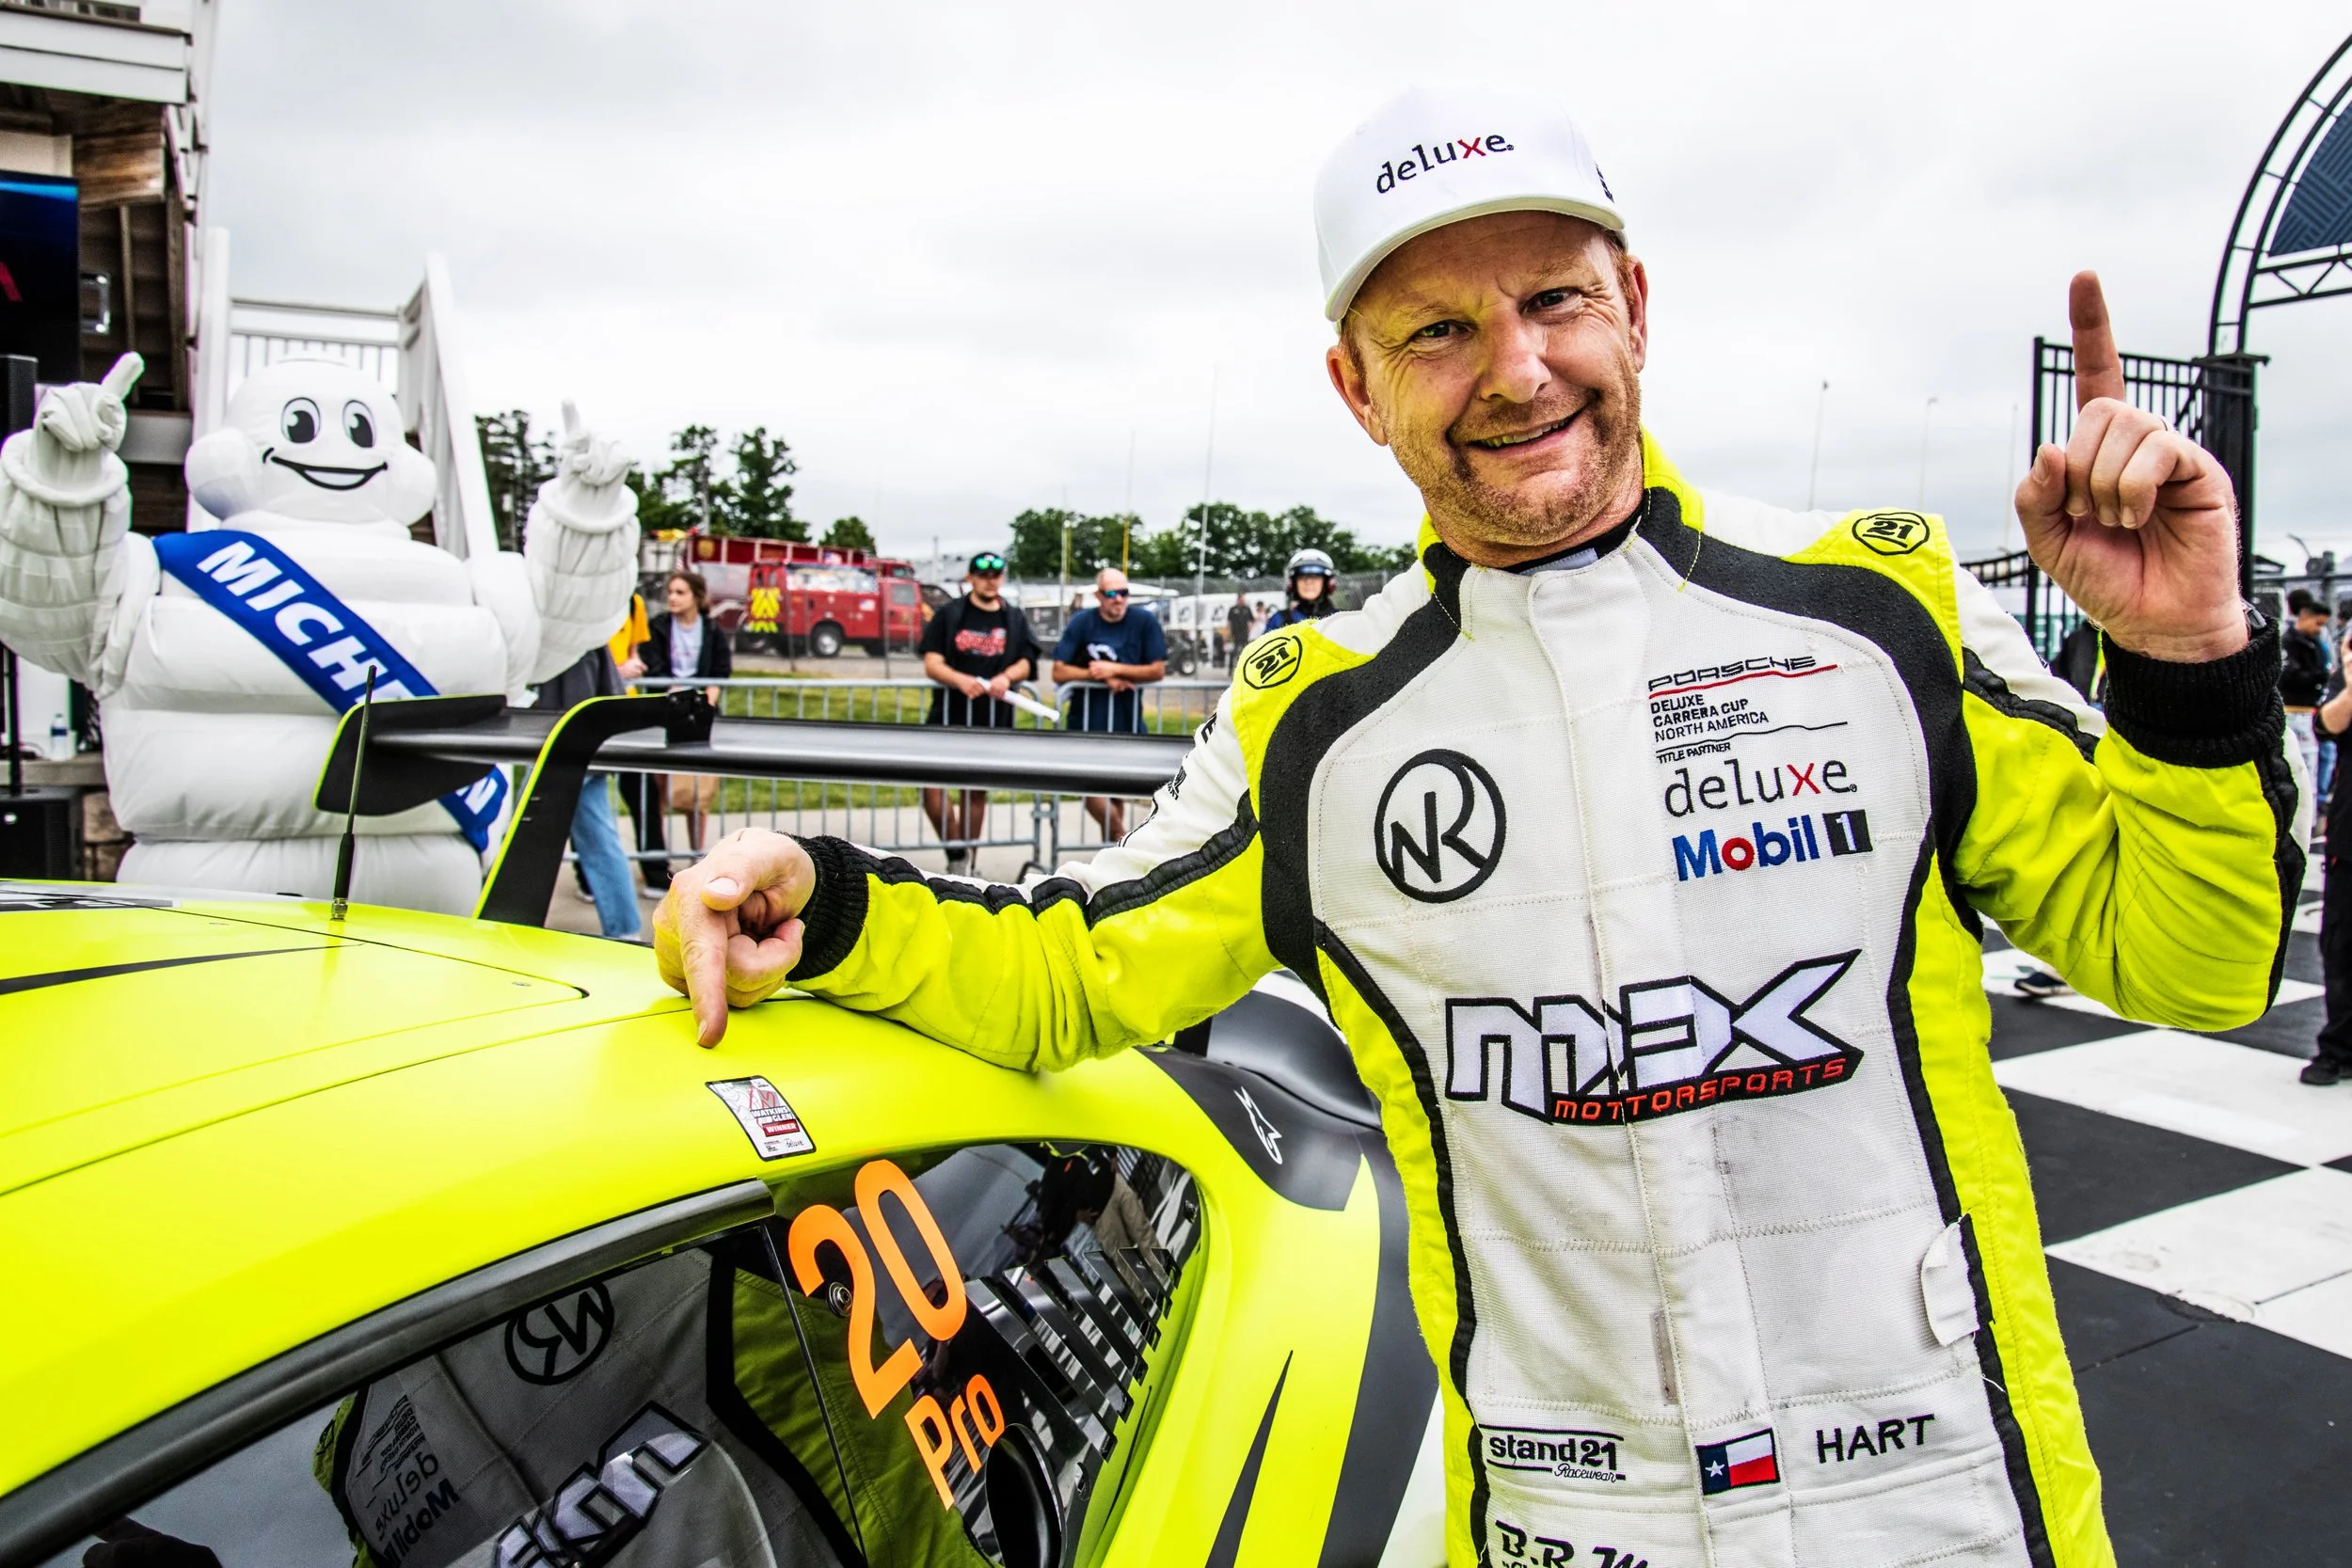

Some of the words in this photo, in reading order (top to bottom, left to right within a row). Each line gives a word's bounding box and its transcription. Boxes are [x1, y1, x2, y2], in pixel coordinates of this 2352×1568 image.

[1866, 520, 1914, 540] 21
[1255, 646, 1290, 679] 21
[1647, 656, 1817, 691] PORSCHE
[1650, 693, 1705, 715] DELUXE
[1653, 705, 1720, 728] CARRERA
[1721, 698, 1749, 715] CUP
[1655, 722, 1704, 742] NORTH
[1707, 711, 1770, 732] AMERICA
[1657, 750, 1686, 764] TITLE
[1687, 741, 1731, 758] PARTNER
[1672, 815, 1821, 882] Mobil
[765, 1122, 798, 1133] WINNER
[787, 1158, 968, 1421] 20
[903, 1373, 1006, 1513] Pro
[1488, 1433, 1618, 1471] stand21
[1815, 1412, 1936, 1465] HART
[1553, 1462, 1618, 1483] Racewear
